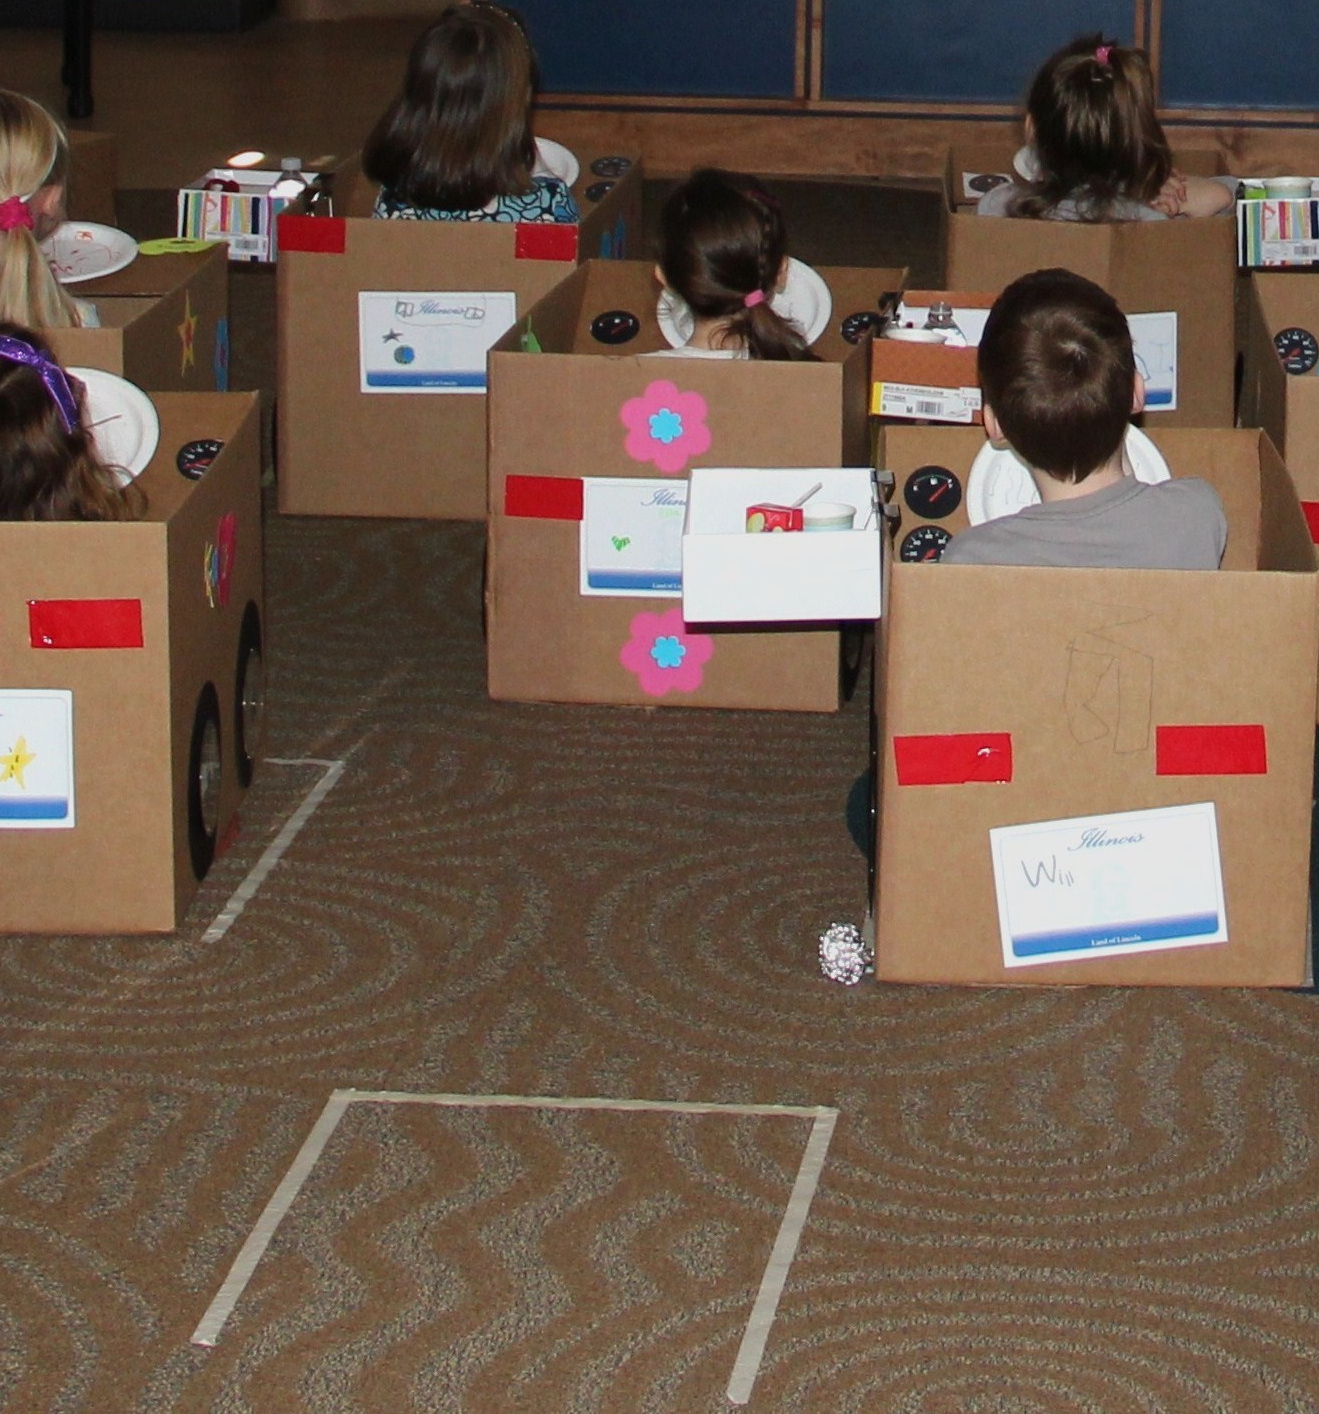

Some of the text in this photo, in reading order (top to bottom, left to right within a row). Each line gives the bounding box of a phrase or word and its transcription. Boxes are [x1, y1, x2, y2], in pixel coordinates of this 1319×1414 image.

[641, 488, 689, 507] Illin
[1067, 826, 1145, 852] Illinois
[1021, 854, 1075, 888] Will
